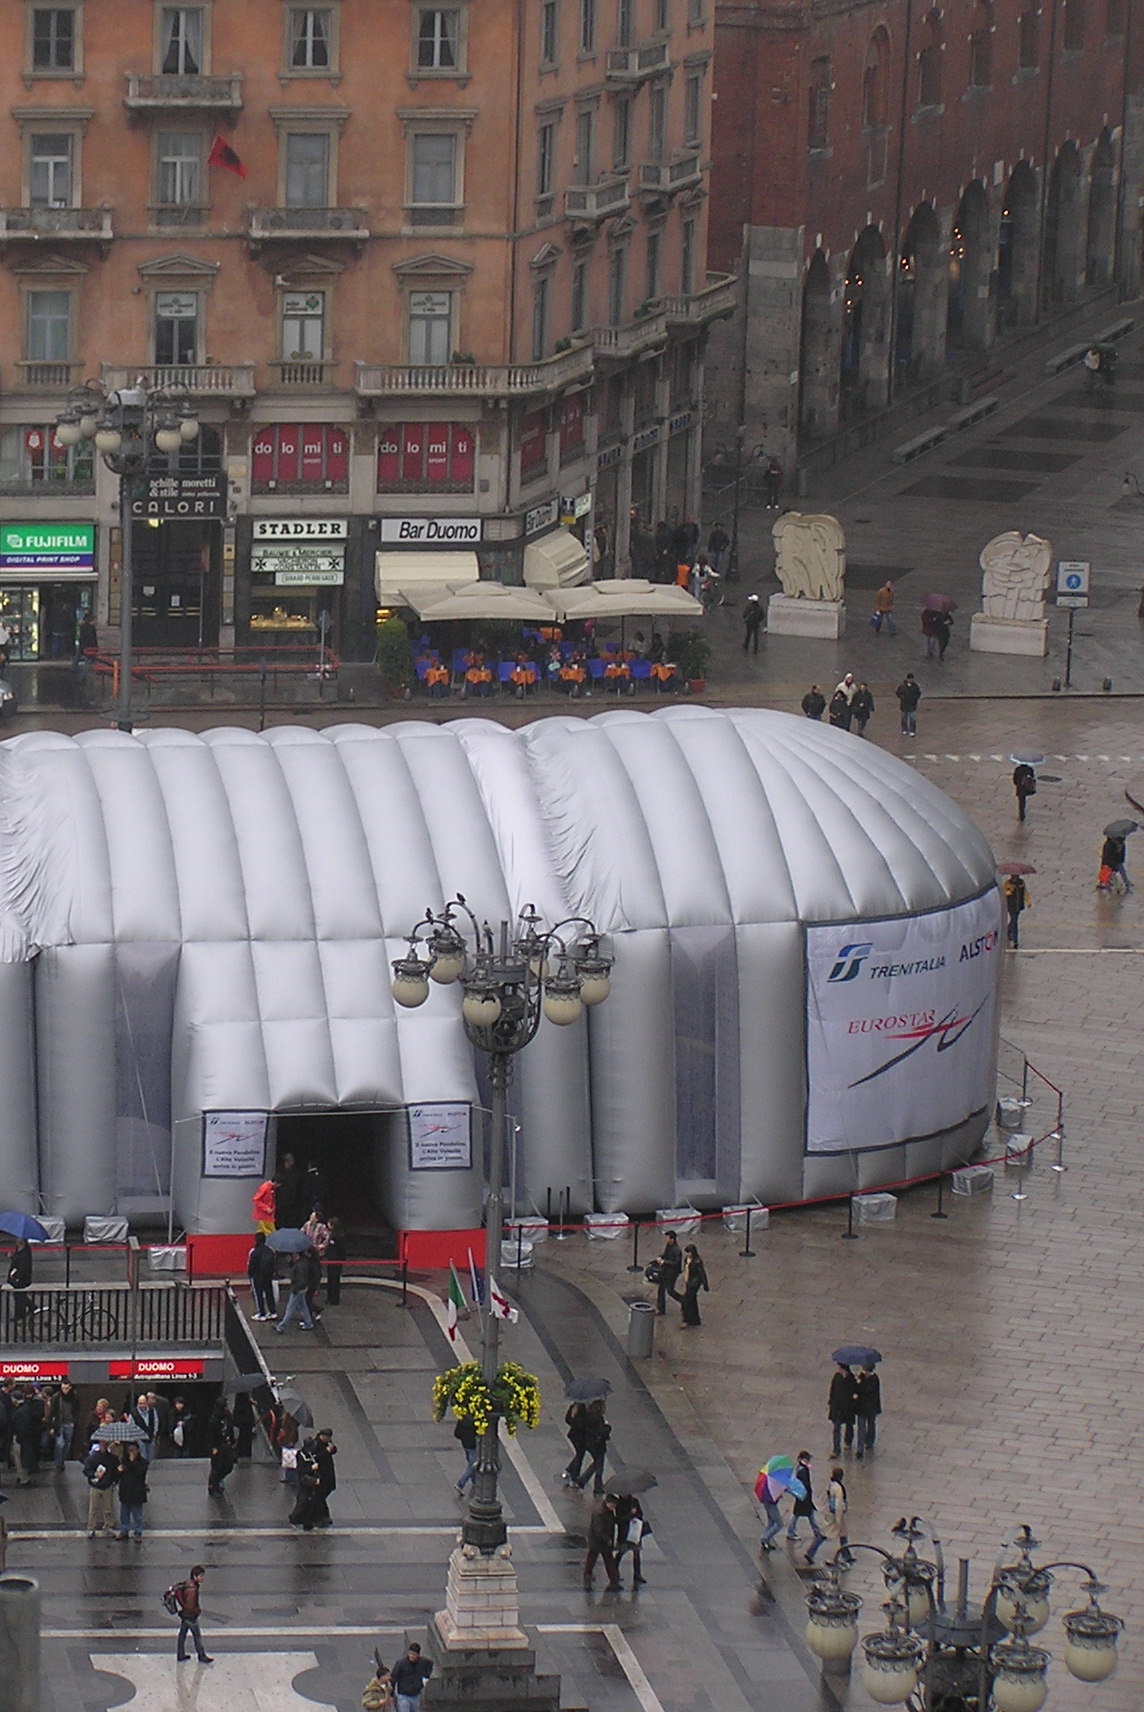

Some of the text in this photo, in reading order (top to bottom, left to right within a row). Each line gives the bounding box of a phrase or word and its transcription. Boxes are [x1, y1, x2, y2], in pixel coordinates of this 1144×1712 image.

[255, 442, 342, 454] do lo mi ti
[381, 442, 467, 453] do lo mi ti
[149, 478, 216, 488] achille moretti
[132, 501, 214, 513] CALORI
[259, 523, 342, 535] STADLER
[399, 521, 478, 539] Bar Duomo
[26, 536, 87, 547] FUJIFILM
[870, 956, 946, 979] TRENITALIA
[848, 1009, 937, 1034] EUROSTAR
[3, 1365, 39, 1373] DUOMO
[138, 1362, 175, 1371] DUOMO
